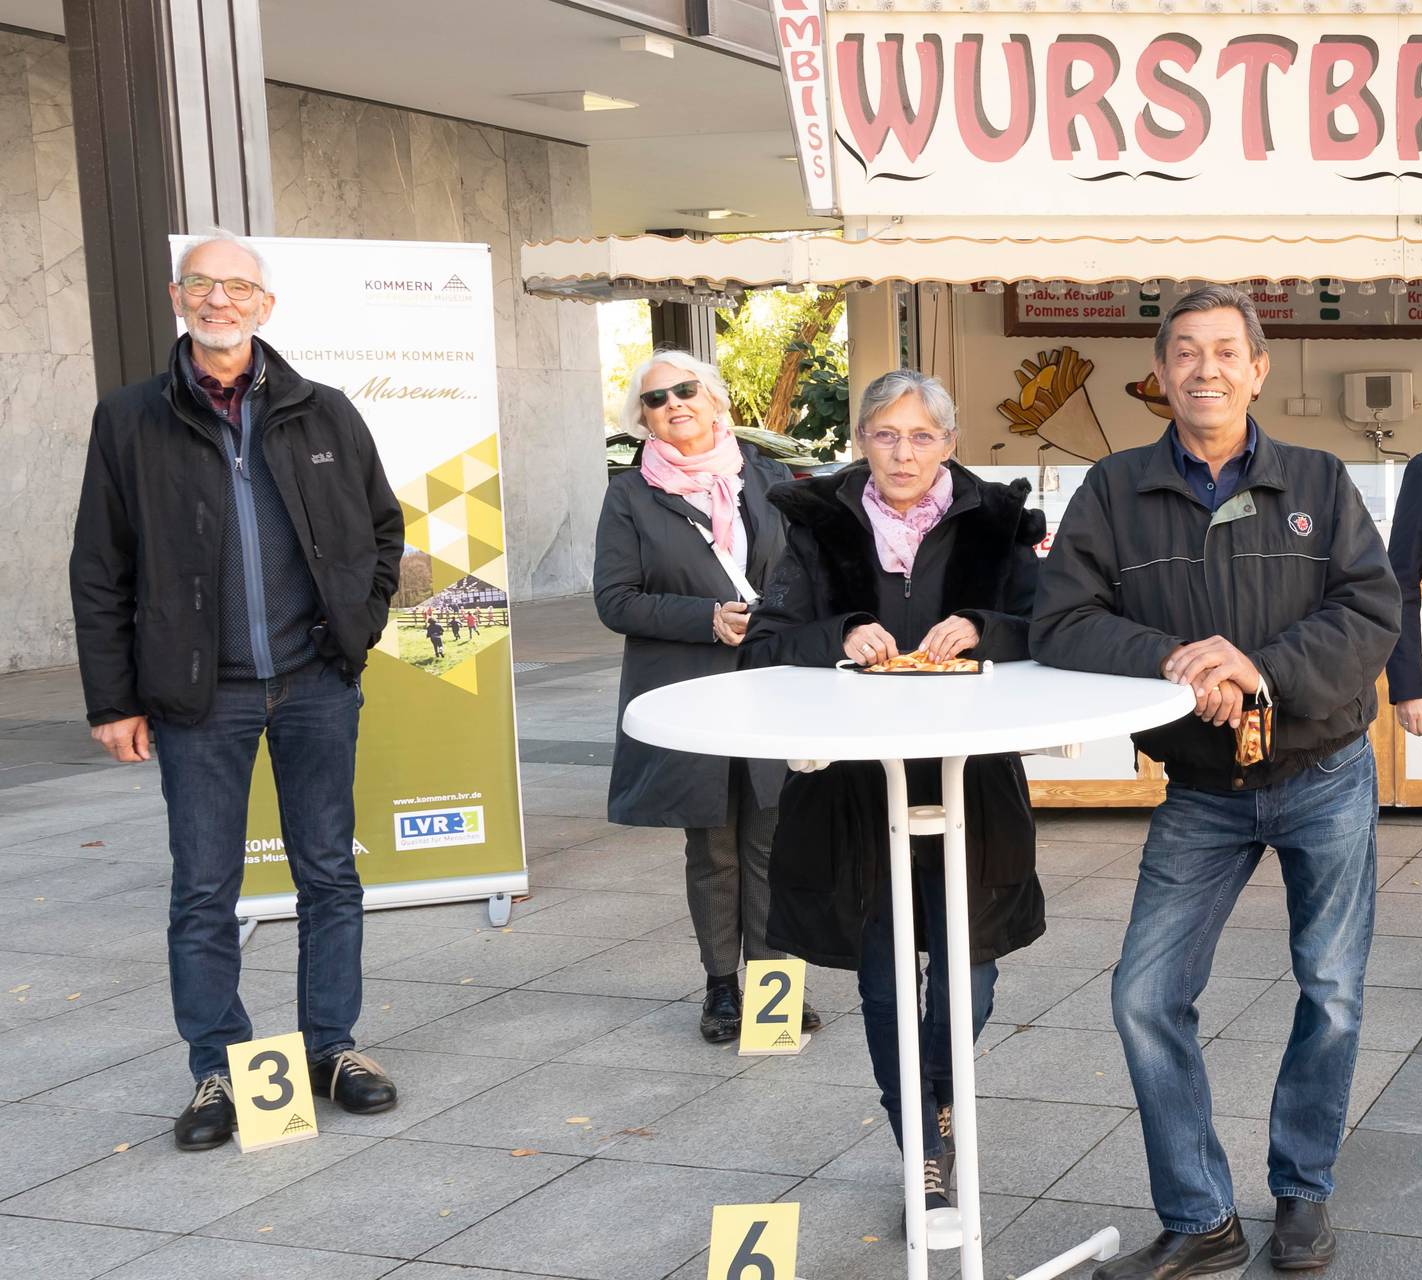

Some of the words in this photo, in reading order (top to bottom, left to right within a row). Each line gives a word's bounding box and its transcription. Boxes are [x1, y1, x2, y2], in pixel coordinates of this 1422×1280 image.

[778, 0, 826, 179] MBISS
[364, 279, 433, 292] KOMMERN
[1025, 303, 1080, 317] Pommes
[1083, 305, 1126, 317] spezial
[1256, 308, 1294, 319] wurst
[402, 351, 475, 362] KOMMERN
[393, 792, 481, 806] www.kommern.lvr.de
[403, 816, 450, 836] LVR
[755, 970, 792, 1025] 2
[247, 1050, 295, 1112] 3
[726, 1220, 775, 1280] 6
